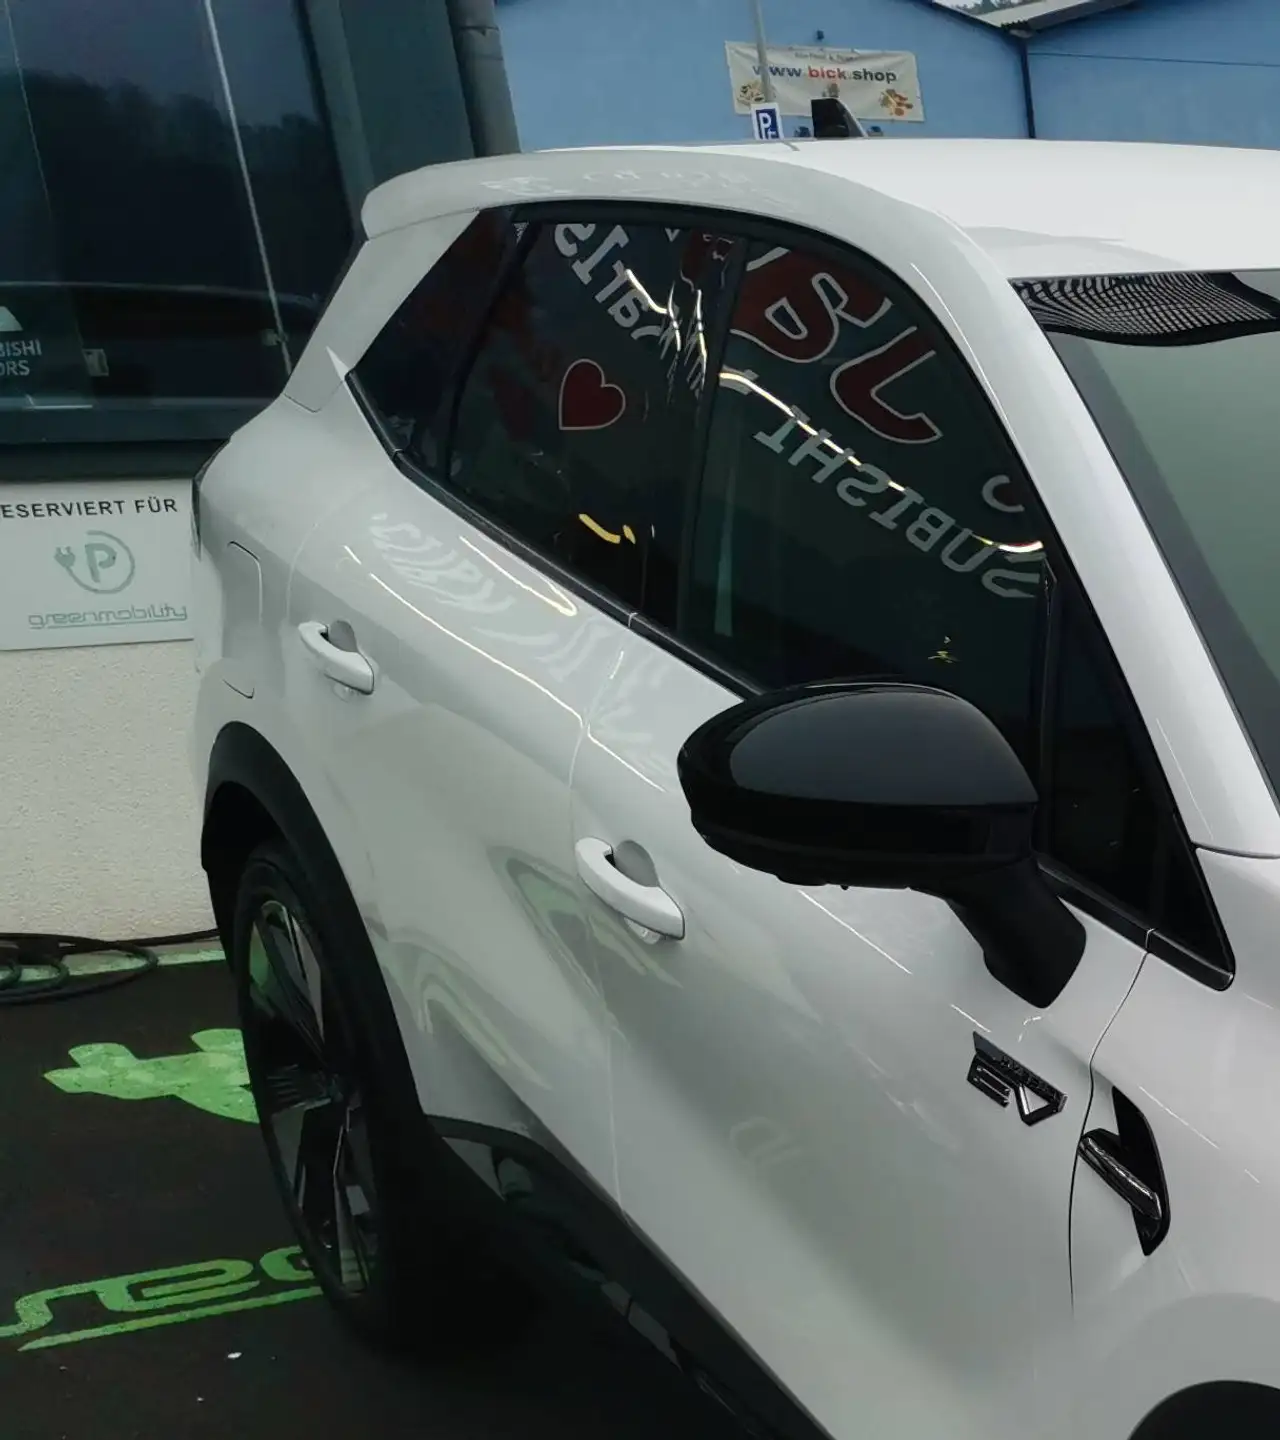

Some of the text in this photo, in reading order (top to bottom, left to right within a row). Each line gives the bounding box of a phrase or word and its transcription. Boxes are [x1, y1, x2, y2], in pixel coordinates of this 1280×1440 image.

[0, 496, 178, 519] ESERVIERT FÜR
[28, 603, 188, 630] greenmobility
